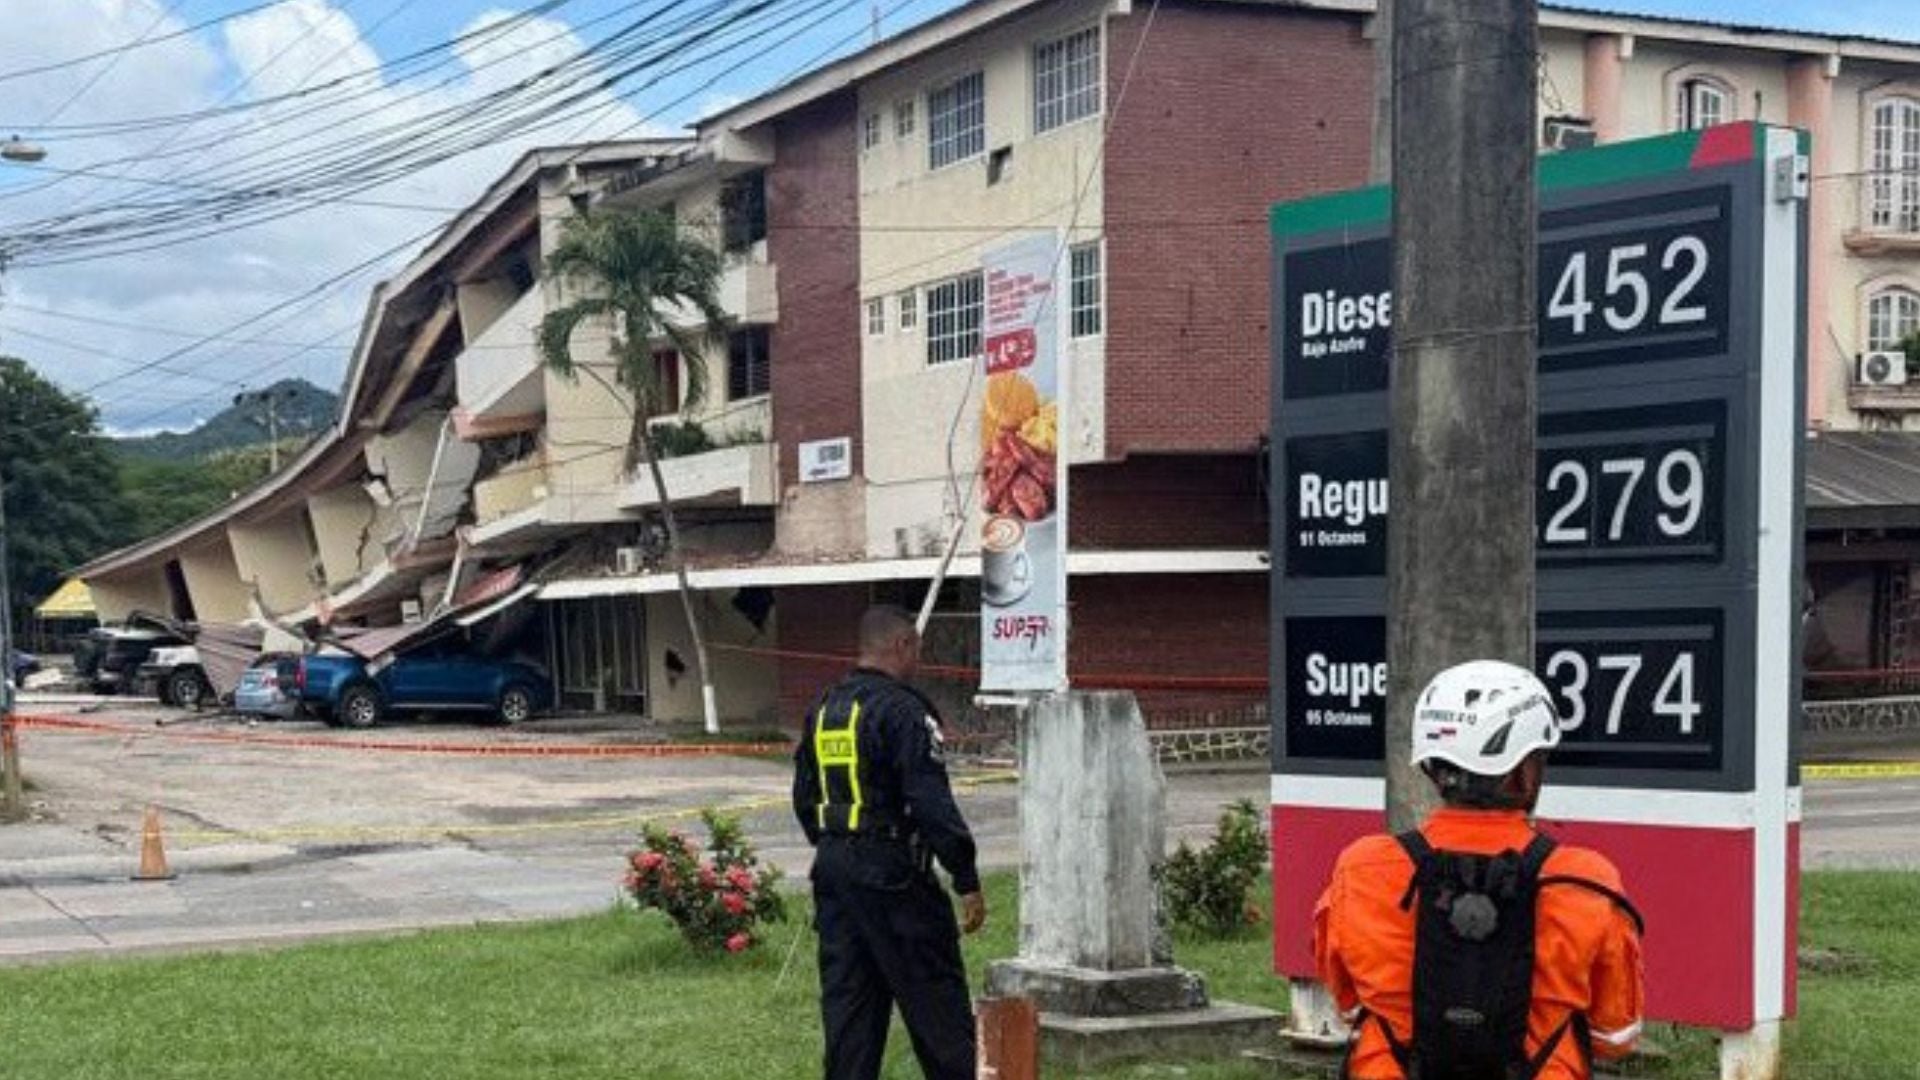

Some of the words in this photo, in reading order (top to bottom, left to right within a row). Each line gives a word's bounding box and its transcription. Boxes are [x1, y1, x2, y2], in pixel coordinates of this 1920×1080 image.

[1303, 290, 1391, 337] Diese
[1548, 235, 1709, 334] 452
[1300, 474, 1388, 526] Regu
[1547, 449, 1703, 541] 279
[1306, 653, 1387, 708] Supe
[1547, 650, 1701, 734] 374
